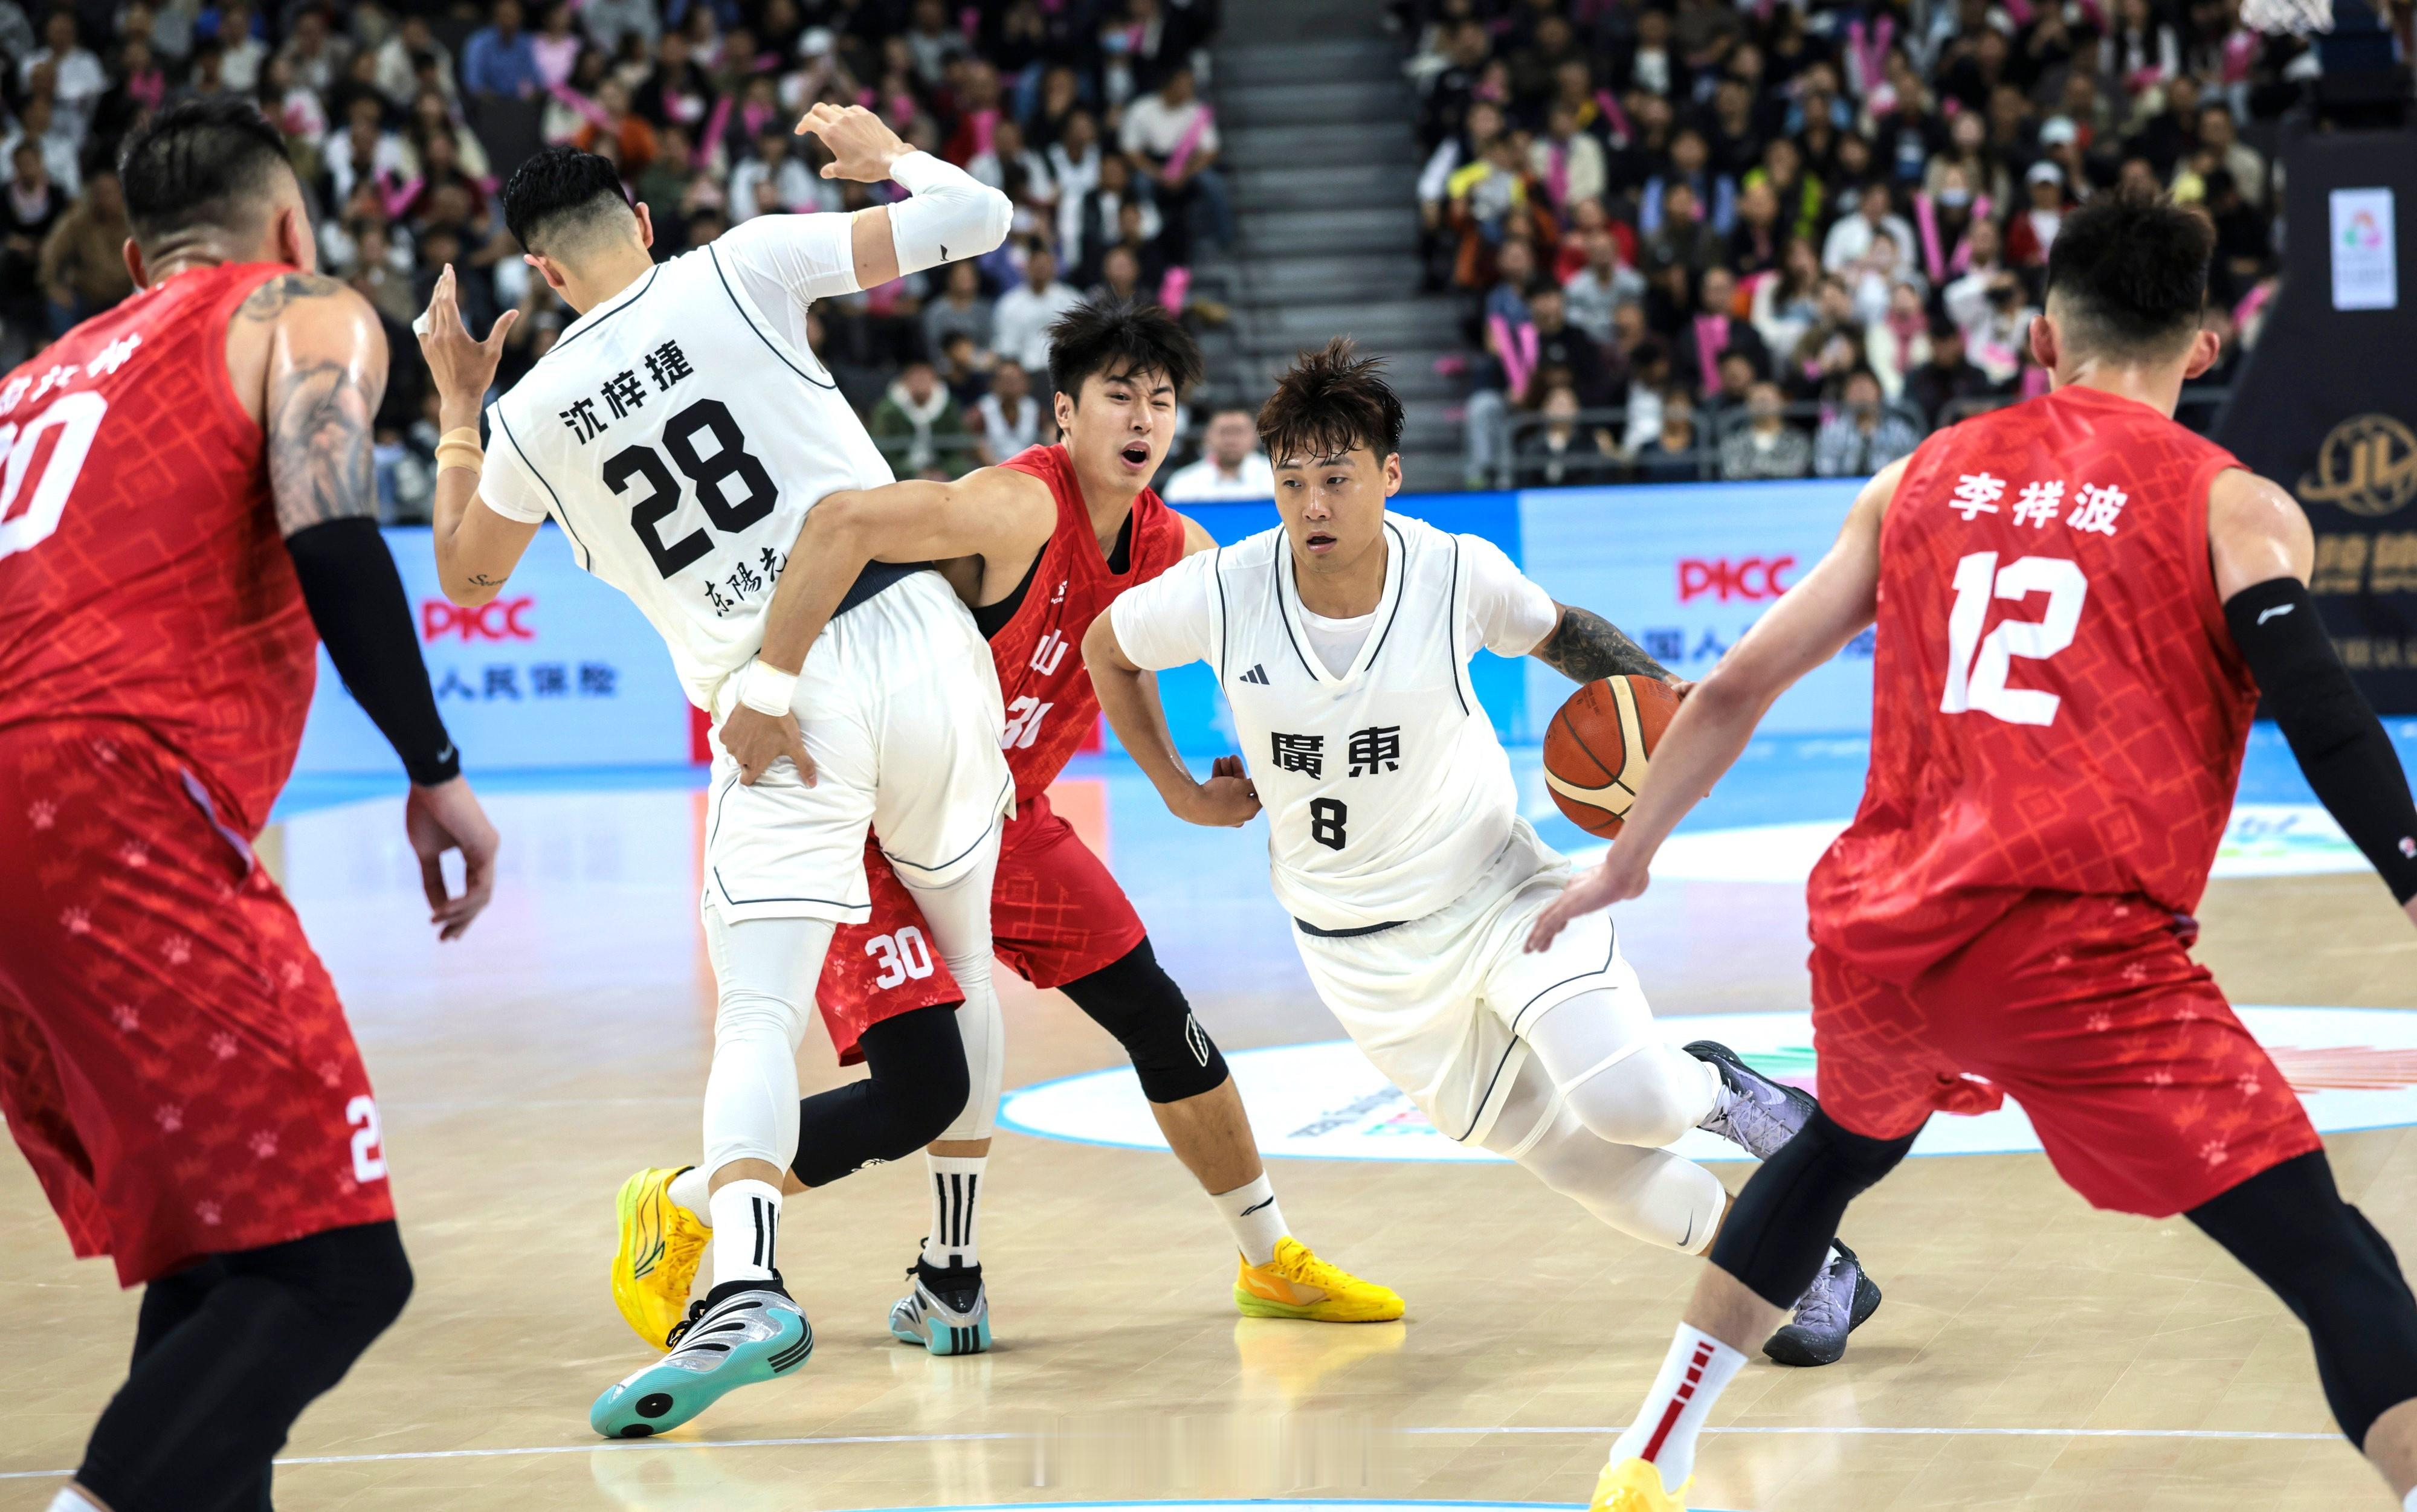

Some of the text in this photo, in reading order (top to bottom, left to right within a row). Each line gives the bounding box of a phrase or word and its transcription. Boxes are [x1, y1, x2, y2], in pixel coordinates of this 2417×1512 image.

[559, 339, 694, 445] 沈梓捷
[0, 391, 108, 562] 0
[602, 398, 779, 580] 28
[1948, 472, 2128, 537] 李祥波
[1679, 556, 1795, 600] PICC
[424, 597, 535, 642] PICC
[1940, 551, 2088, 727] 12
[437, 661, 619, 701] 人民保险
[1271, 725, 1401, 780] 廣東
[1309, 797, 1347, 851] 8
[864, 925, 935, 990] 30
